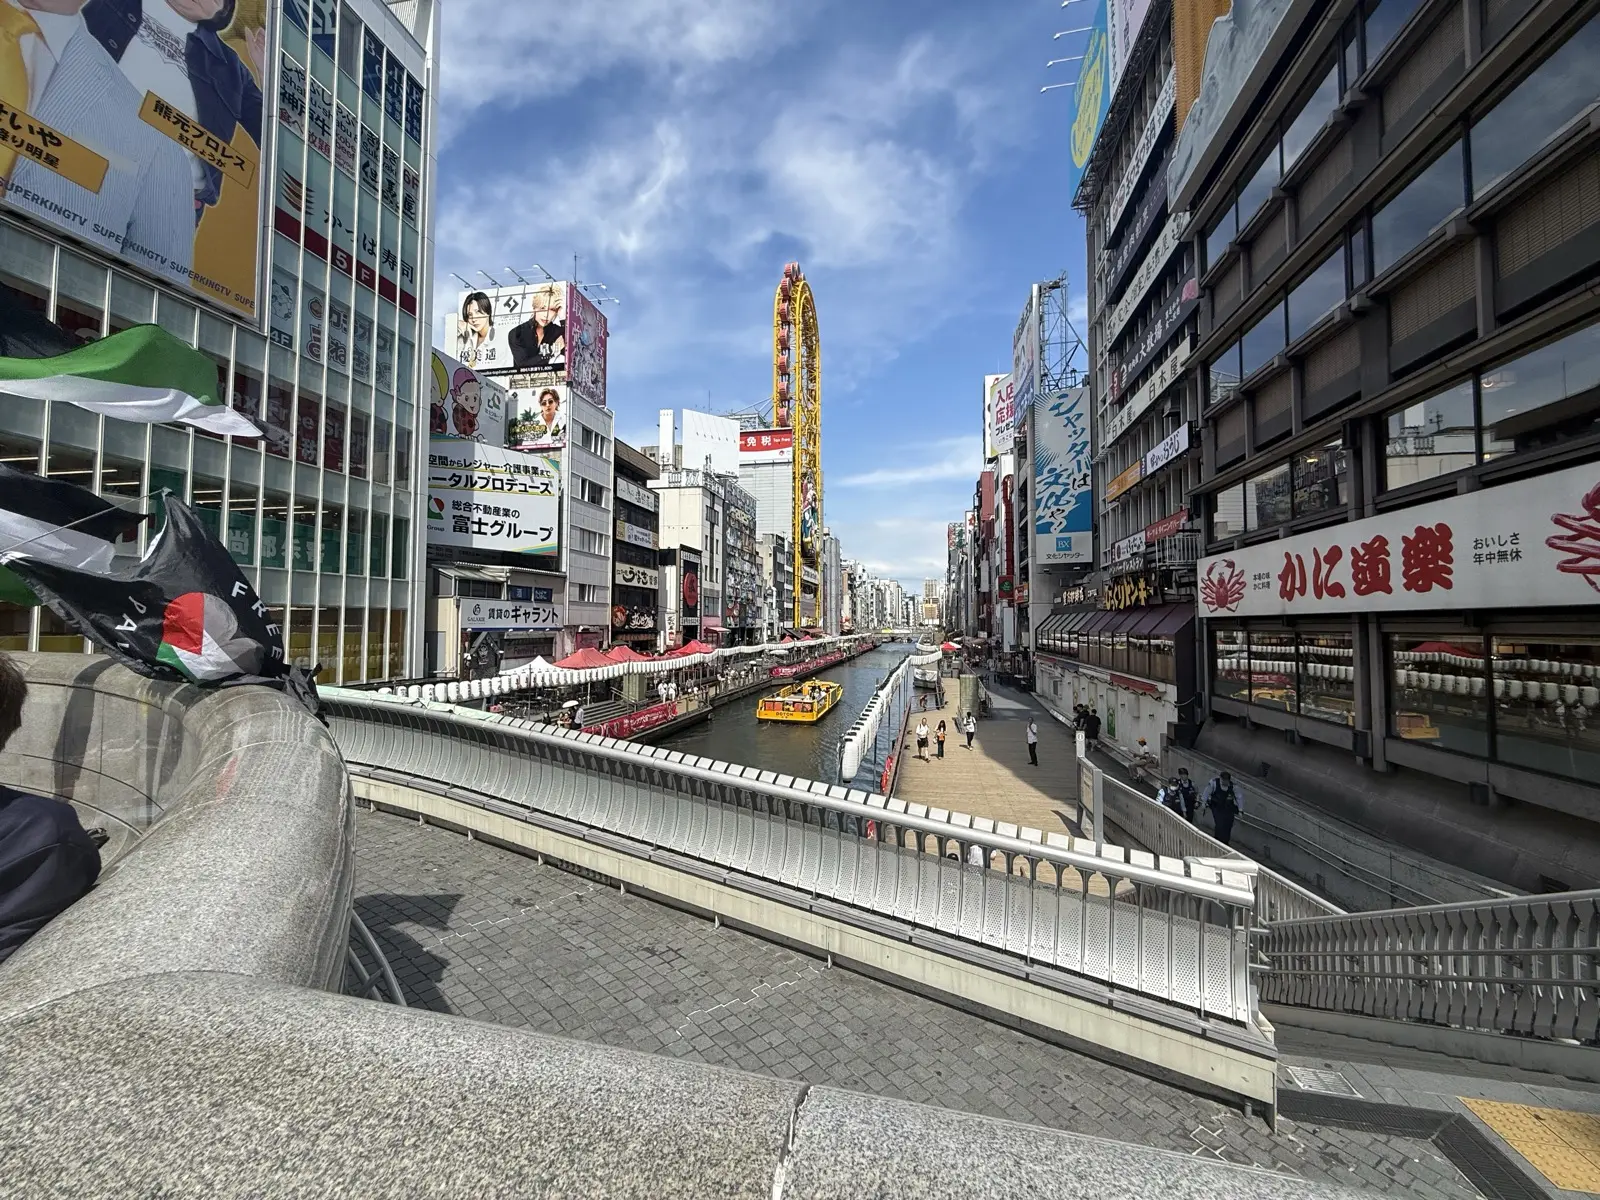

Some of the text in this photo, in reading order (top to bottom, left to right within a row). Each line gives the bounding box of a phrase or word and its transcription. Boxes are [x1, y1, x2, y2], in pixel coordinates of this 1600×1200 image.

[280, 85, 332, 137] 神戸牛
[153, 99, 246, 172] 熊元プロレス
[178, 133, 227, 169] 紅しょうが
[403, 168, 420, 190] 6F
[92, 222, 168, 266] SUPERKINGTV
[169, 261, 232, 297] SUPERKINGTV
[234, 292, 256, 309] SUPE
[336, 250, 370, 281] 5F
[270, 329, 290, 348] 4F
[1149, 355, 1179, 401] 白木屋
[746, 436, 771, 447] 免税
[452, 499, 521, 519] 総合不動産業の
[452, 514, 554, 542] 富士グループ
[1472, 531, 1521, 550] おいしさ
[1058, 540, 1070, 549] BX
[1472, 548, 1523, 566] 年中無休
[231, 580, 284, 660] FREE
[488, 605, 559, 624] 賃貸のギャラント
